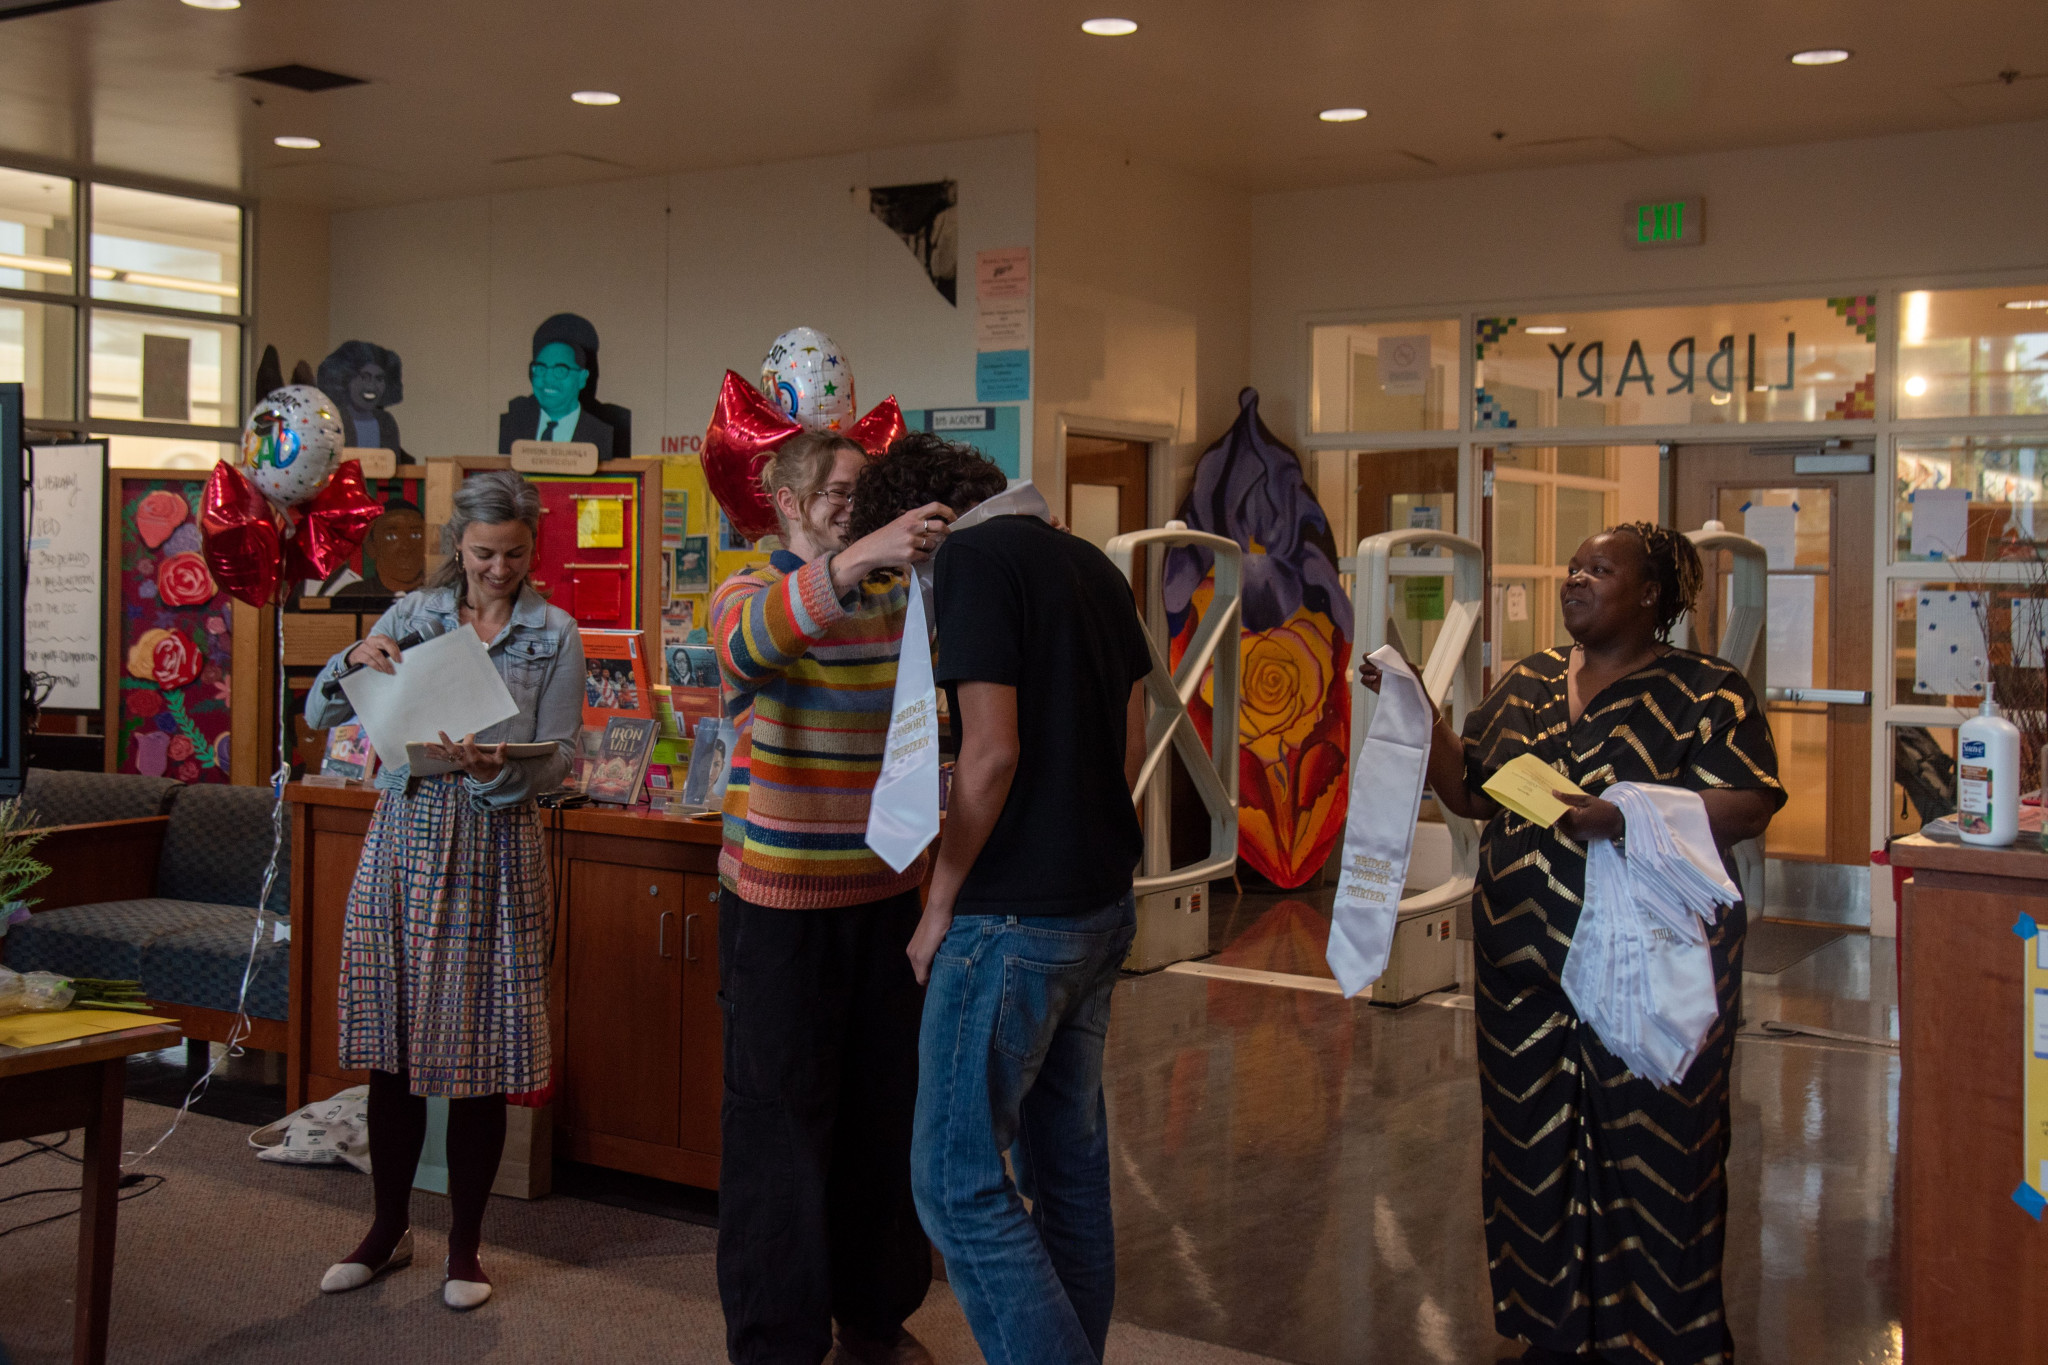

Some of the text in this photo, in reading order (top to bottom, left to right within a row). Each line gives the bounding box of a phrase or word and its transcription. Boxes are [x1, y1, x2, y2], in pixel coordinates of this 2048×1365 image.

[1638, 202, 1686, 242] EXIT
[896, 699, 926, 723] BRIDGE
[611, 727, 644, 741] IRON
[894, 714, 927, 739] COHORT
[1963, 744, 1985, 755] Suave
[1353, 854, 1393, 872] BRIDGE
[1351, 867, 1390, 886] COHORT
[1346, 884, 1387, 904] THIRTEEN
